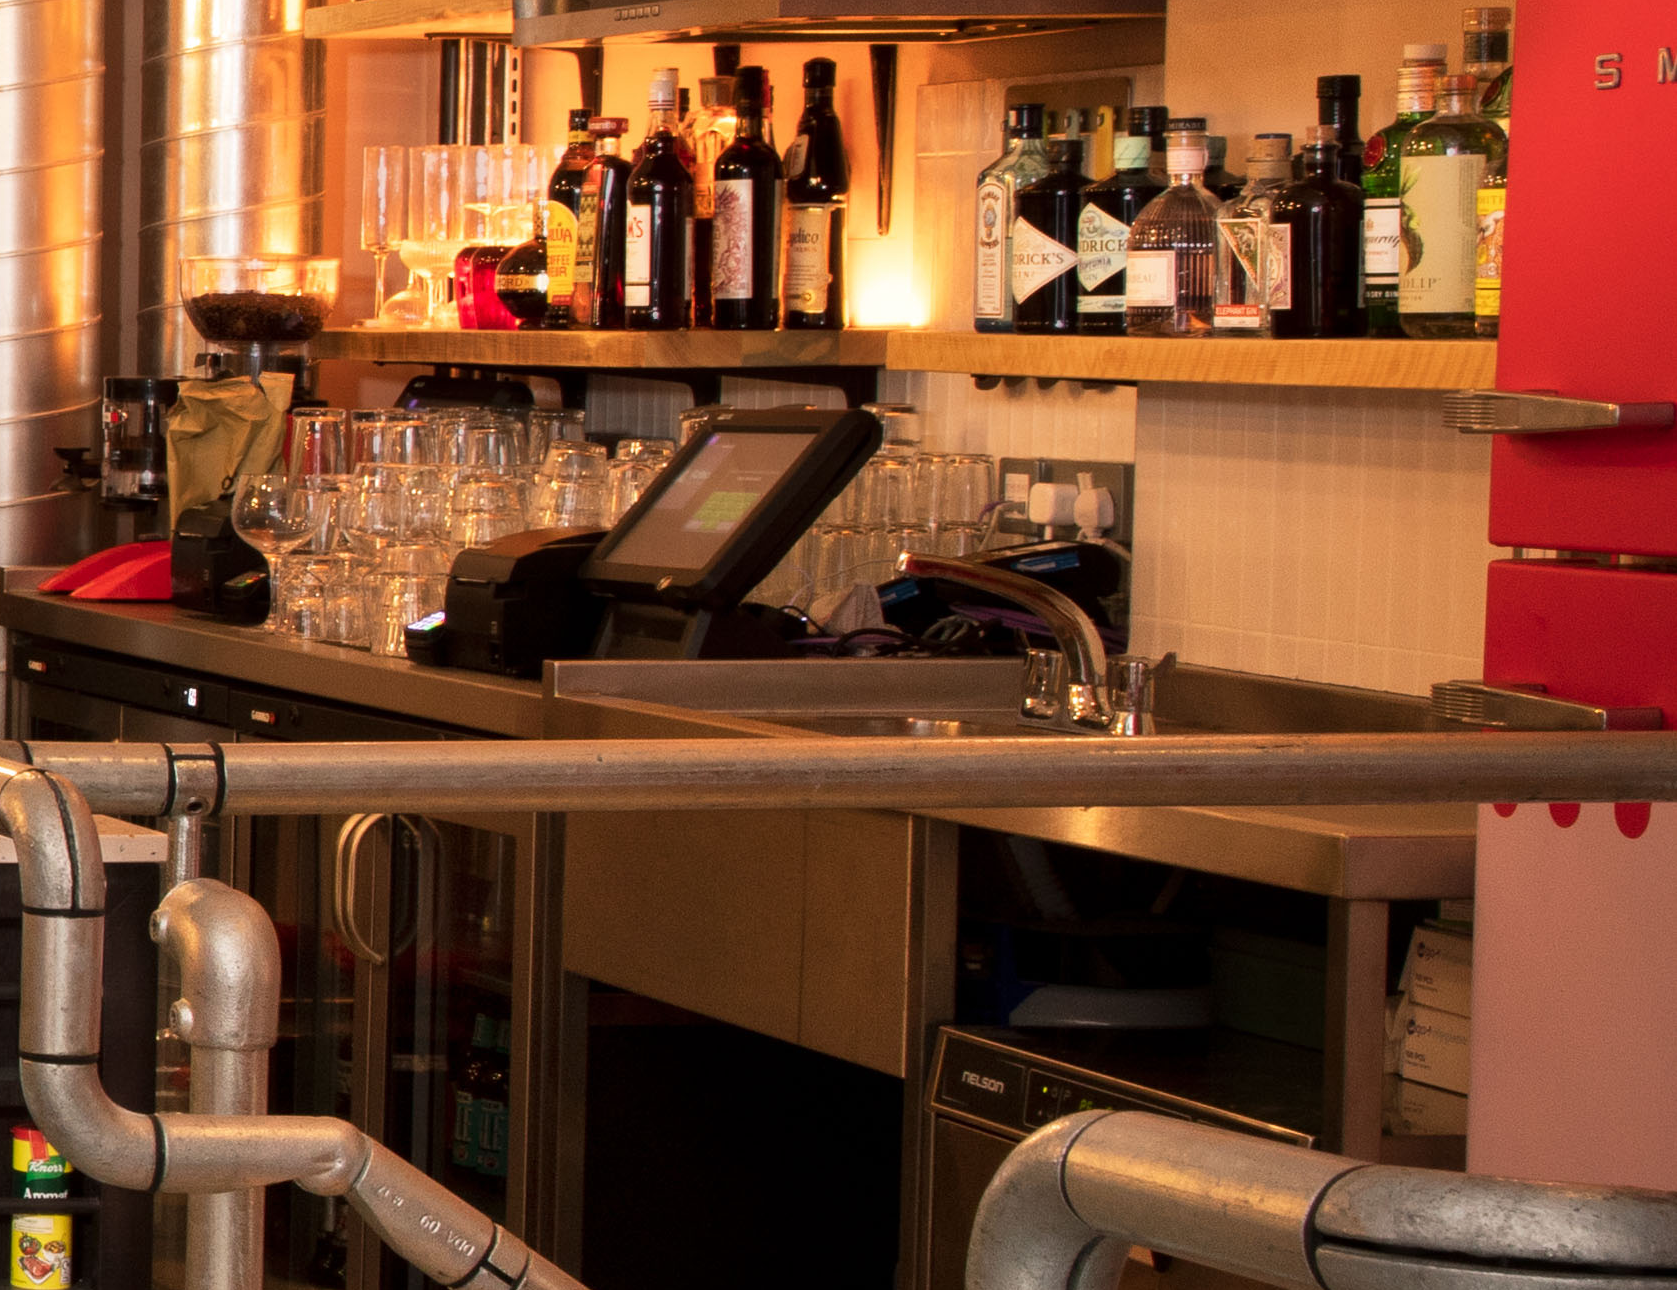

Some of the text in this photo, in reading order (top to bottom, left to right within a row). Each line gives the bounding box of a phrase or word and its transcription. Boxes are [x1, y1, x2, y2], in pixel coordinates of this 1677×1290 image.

[1014, 253, 1064, 266] DRICK'S
[961, 1070, 1005, 1095] NELSON
[29, 1159, 64, 1174] Knorr
